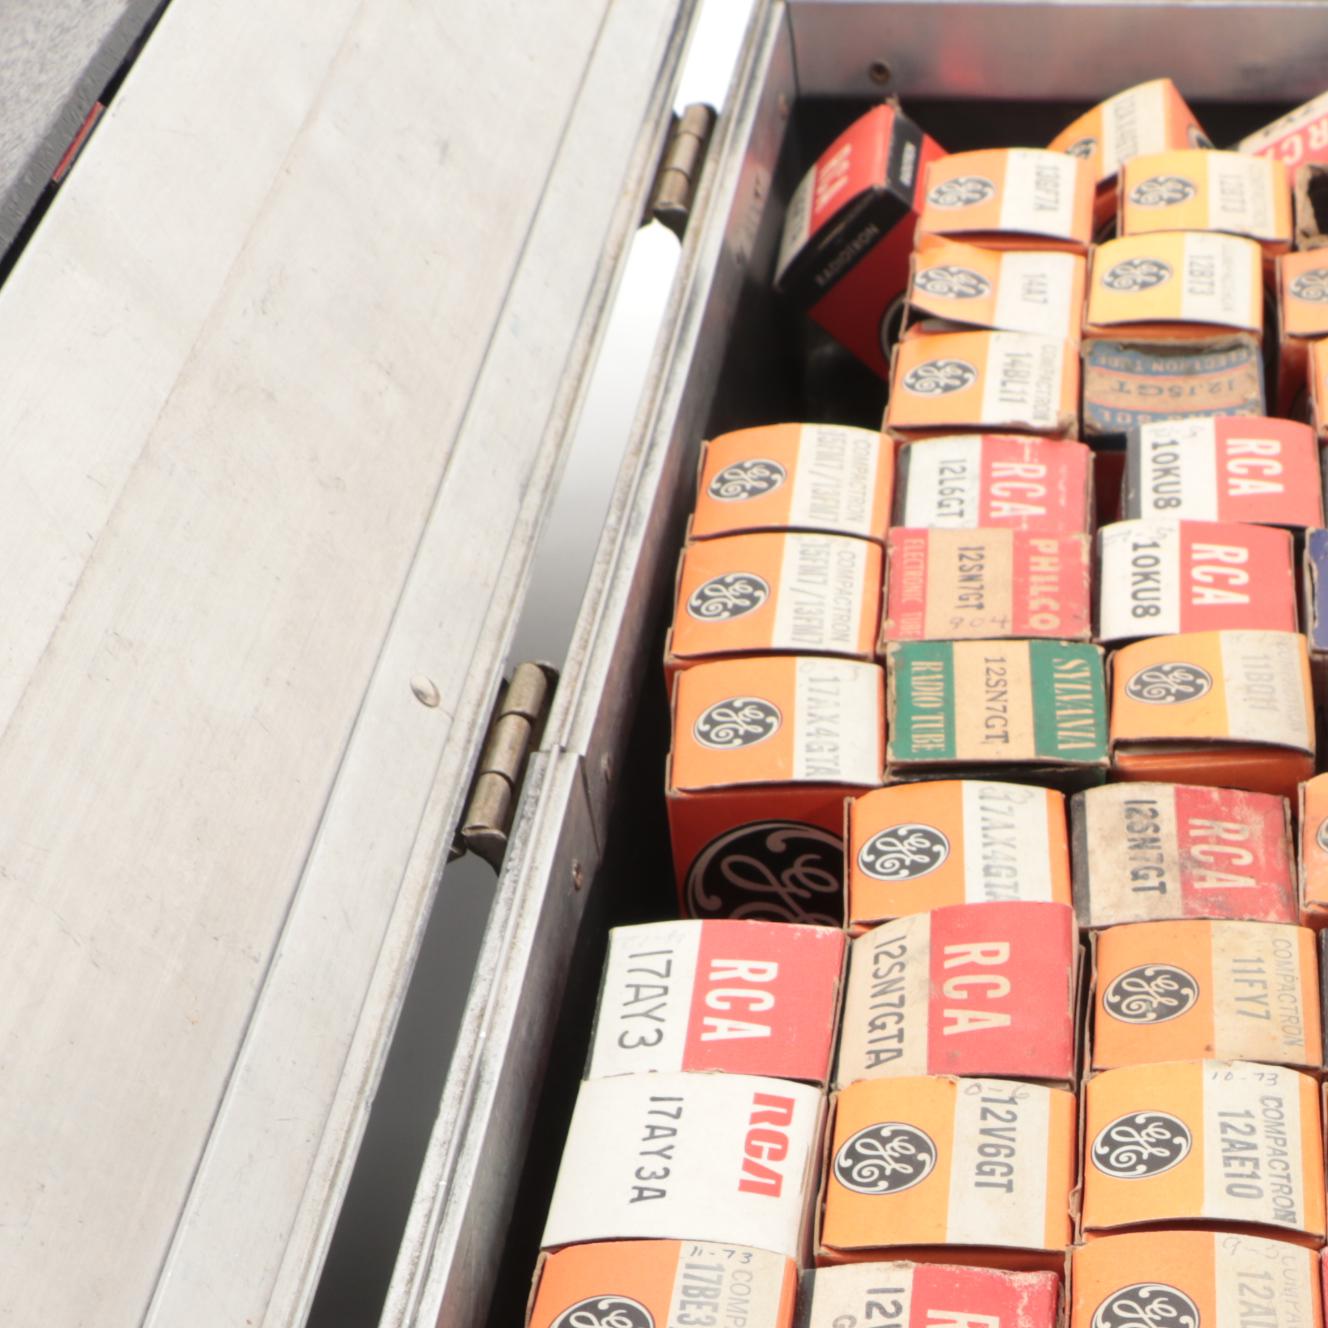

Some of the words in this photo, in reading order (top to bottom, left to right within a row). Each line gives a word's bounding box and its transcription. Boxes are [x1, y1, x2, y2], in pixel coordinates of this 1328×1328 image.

[848, 439, 872, 523] COMPACTRON
[989, 463, 1047, 518] RCA
[1151, 439, 1182, 510] 10KU8
[1226, 438, 1285, 496] RCA
[831, 550, 856, 641] COMPACTRON
[901, 538, 924, 604] ELECTRONIC
[955, 546, 986, 611] 12SN7GT
[1028, 538, 1059, 631] PHILCO
[1130, 541, 1161, 619] 10KU8
[1190, 543, 1250, 606] RCA
[805, 677, 841, 779] 17AX4GTA
[910, 661, 944, 707] RADIO
[983, 656, 1010, 745] 12SN7GT
[1052, 658, 1095, 750] SYLVANIA
[910, 712, 945, 752] TUBE
[1123, 799, 1167, 894] 12SN7GT
[1189, 818, 1256, 889] RCA
[617, 949, 675, 1050] 17AY3
[700, 959, 779, 1042] RCA
[865, 936, 908, 1069] 12SN7GTA
[941, 942, 1012, 1036] RCA
[1231, 957, 1271, 1021] 11FY7
[1272, 938, 1303, 1048] COMPACTRON
[628, 1096, 684, 1204] 17AY3A
[738, 1092, 795, 1199] RCA
[973, 1096, 1018, 1194] 12V6GT
[1217, 1109, 1264, 1199] 12AE10
[1259, 1096, 1296, 1223] COMPACTRON
